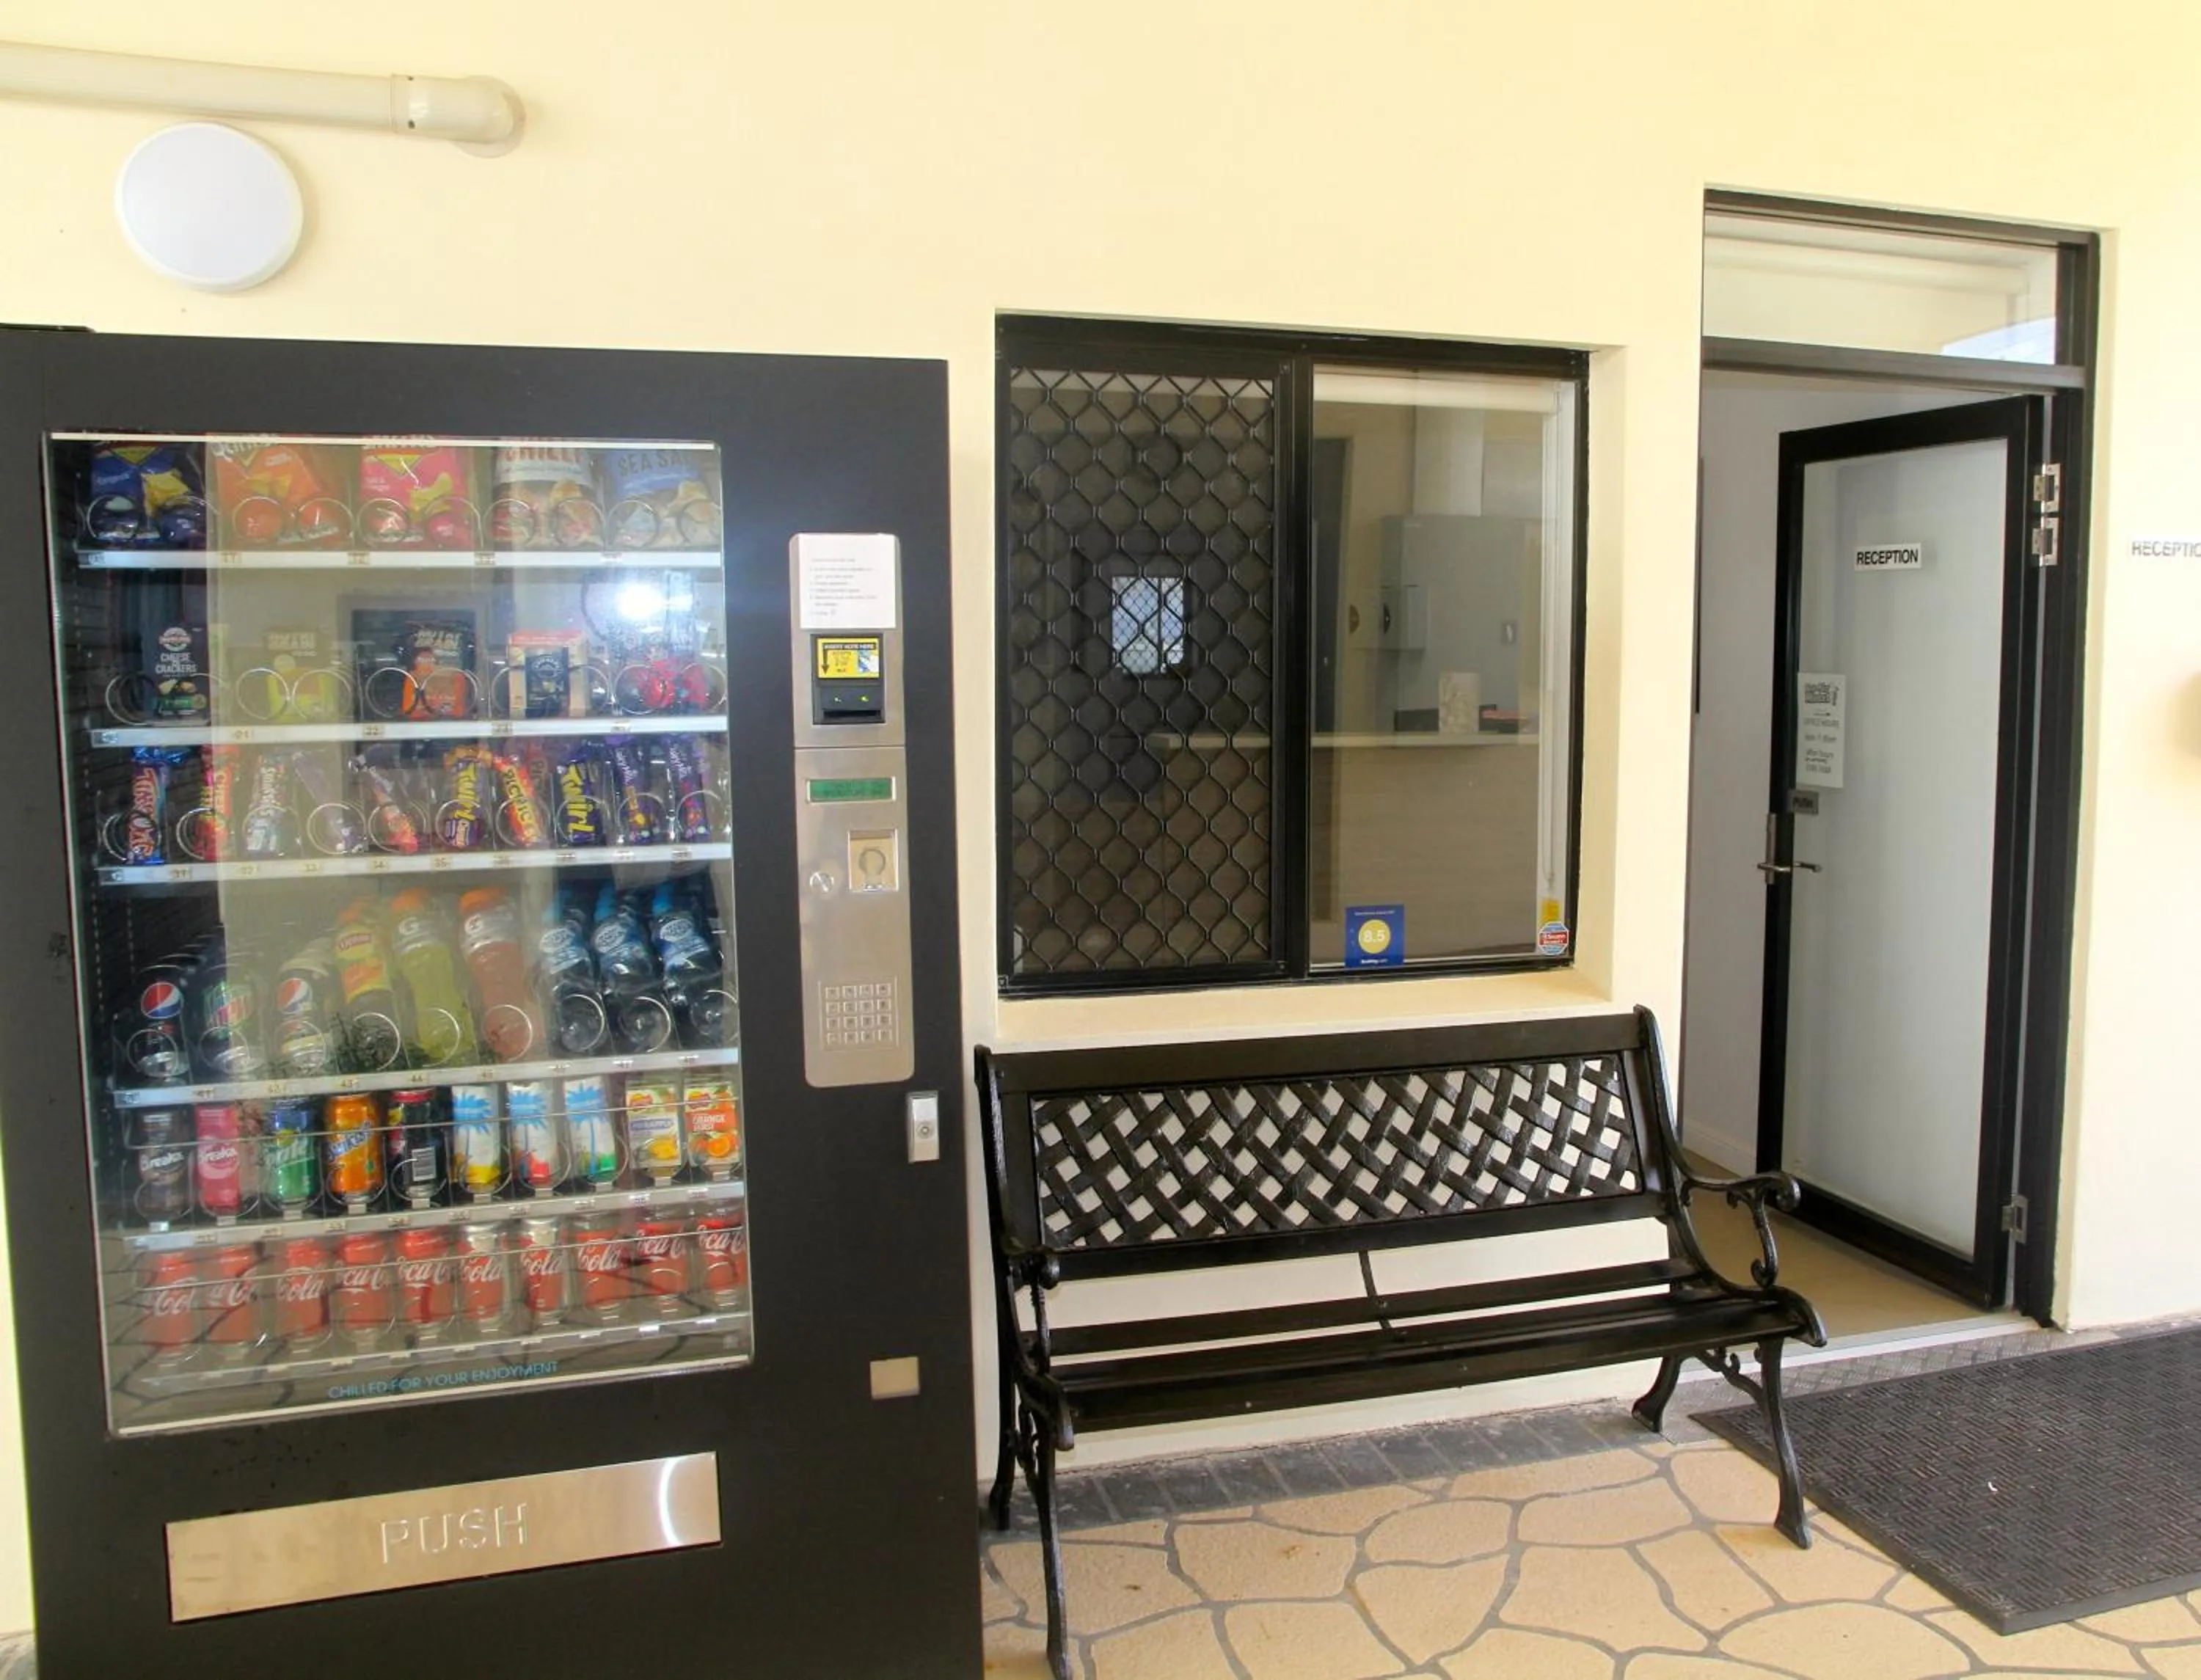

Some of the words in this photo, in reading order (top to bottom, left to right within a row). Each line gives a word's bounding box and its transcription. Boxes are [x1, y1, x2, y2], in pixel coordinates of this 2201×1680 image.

[618, 452, 652, 476] SEA
[1856, 549, 1919, 566] RECEPTION
[160, 652, 191, 662] CHEESE
[155, 663, 197, 674] CRACKERS
[501, 768, 536, 824] PICNIC
[1362, 929, 1386, 943] 8.5
[328, 1382, 388, 1399] CHILLED
[391, 1377, 421, 1392] FOR
[425, 1372, 468, 1387] YOUR
[472, 1361, 558, 1381] ENJOYMENT
[379, 1502, 529, 1564] PUSH
